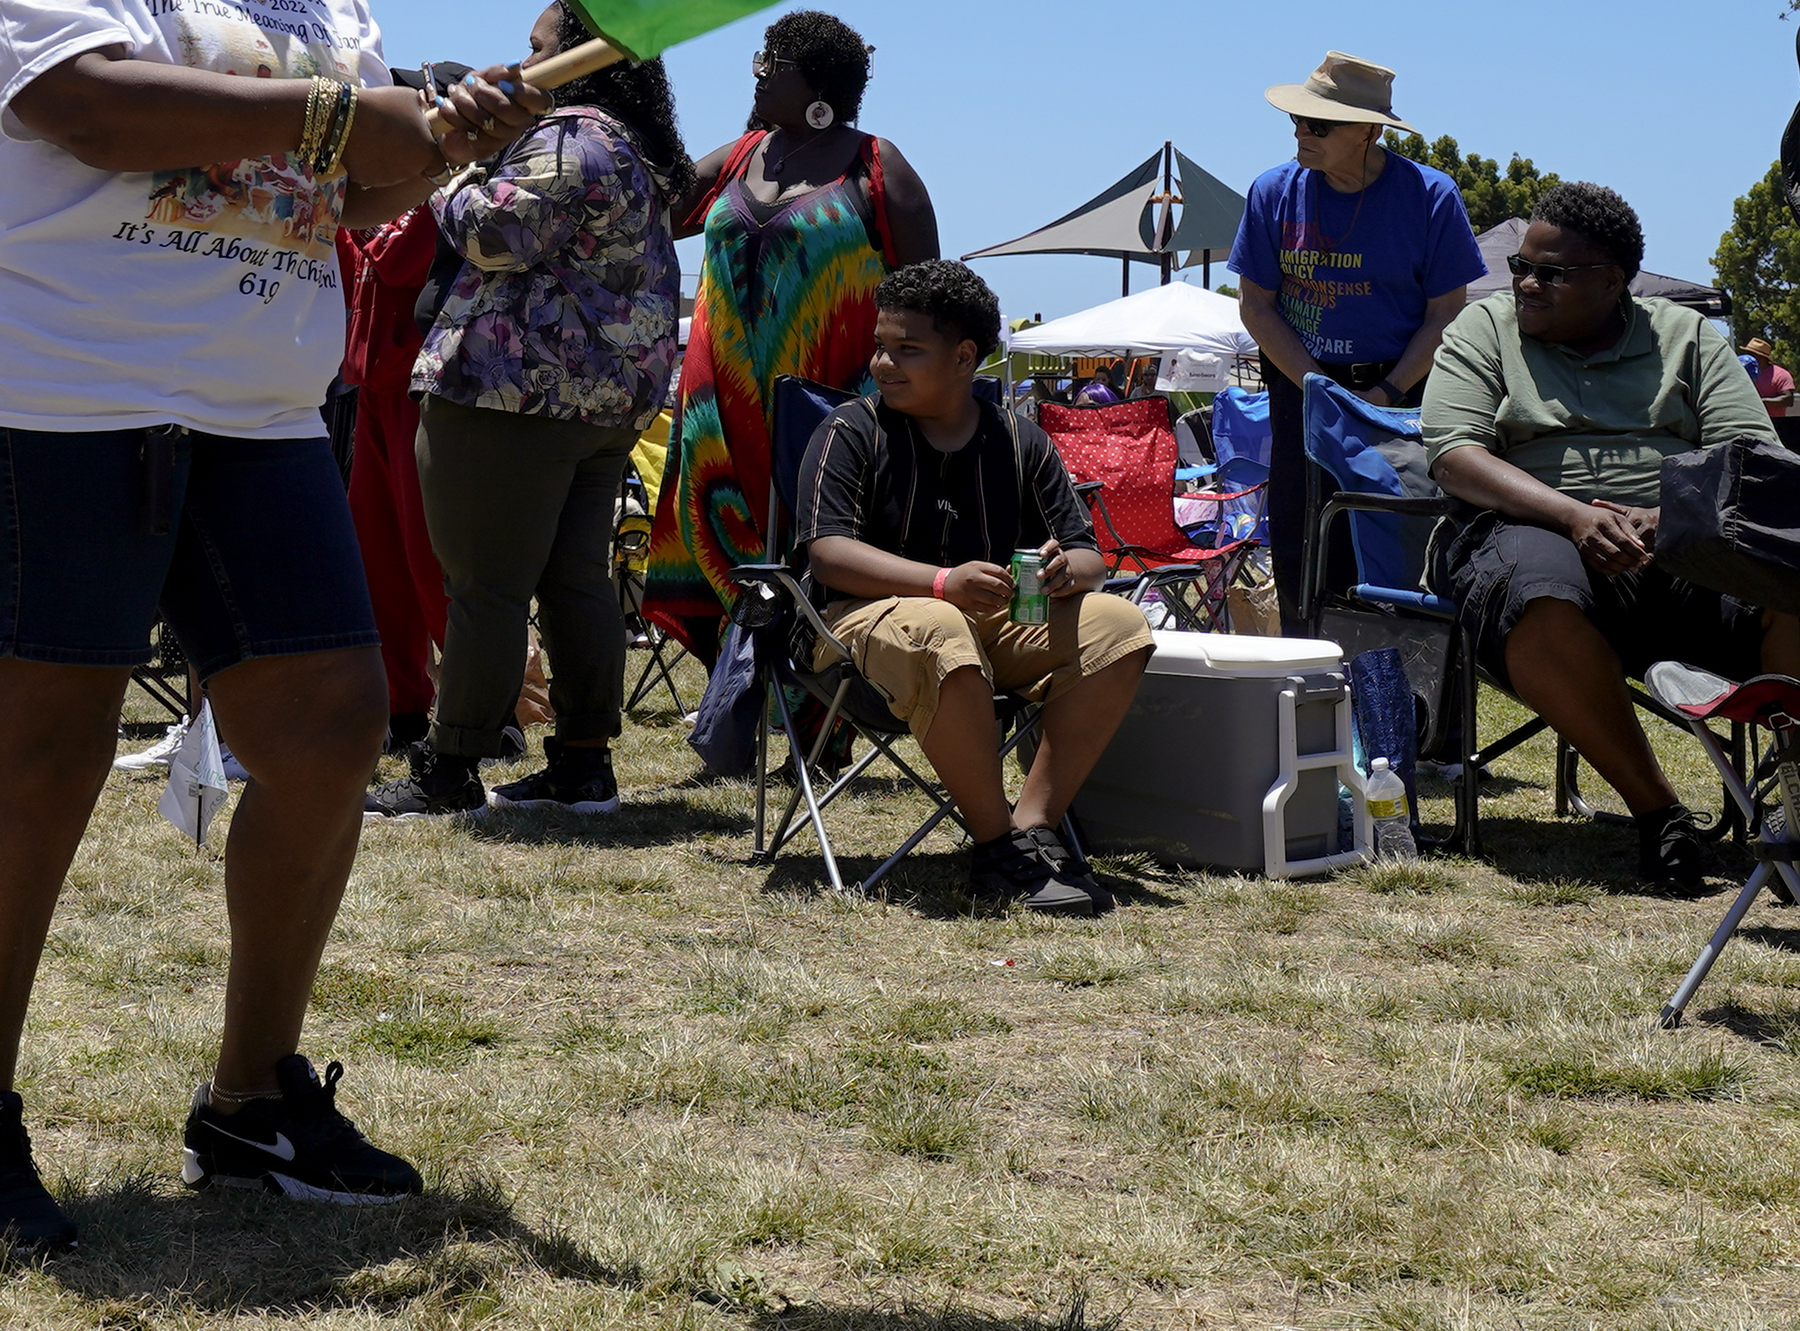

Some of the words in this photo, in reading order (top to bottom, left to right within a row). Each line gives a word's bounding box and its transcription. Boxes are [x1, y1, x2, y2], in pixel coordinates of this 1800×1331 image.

[235, 5, 310, 44] Meaning
[312, 22, 332, 48] Of
[112, 221, 155, 246] It's
[158, 230, 209, 255] All
[202, 236, 269, 268] About
[238, 271, 281, 305] 619
